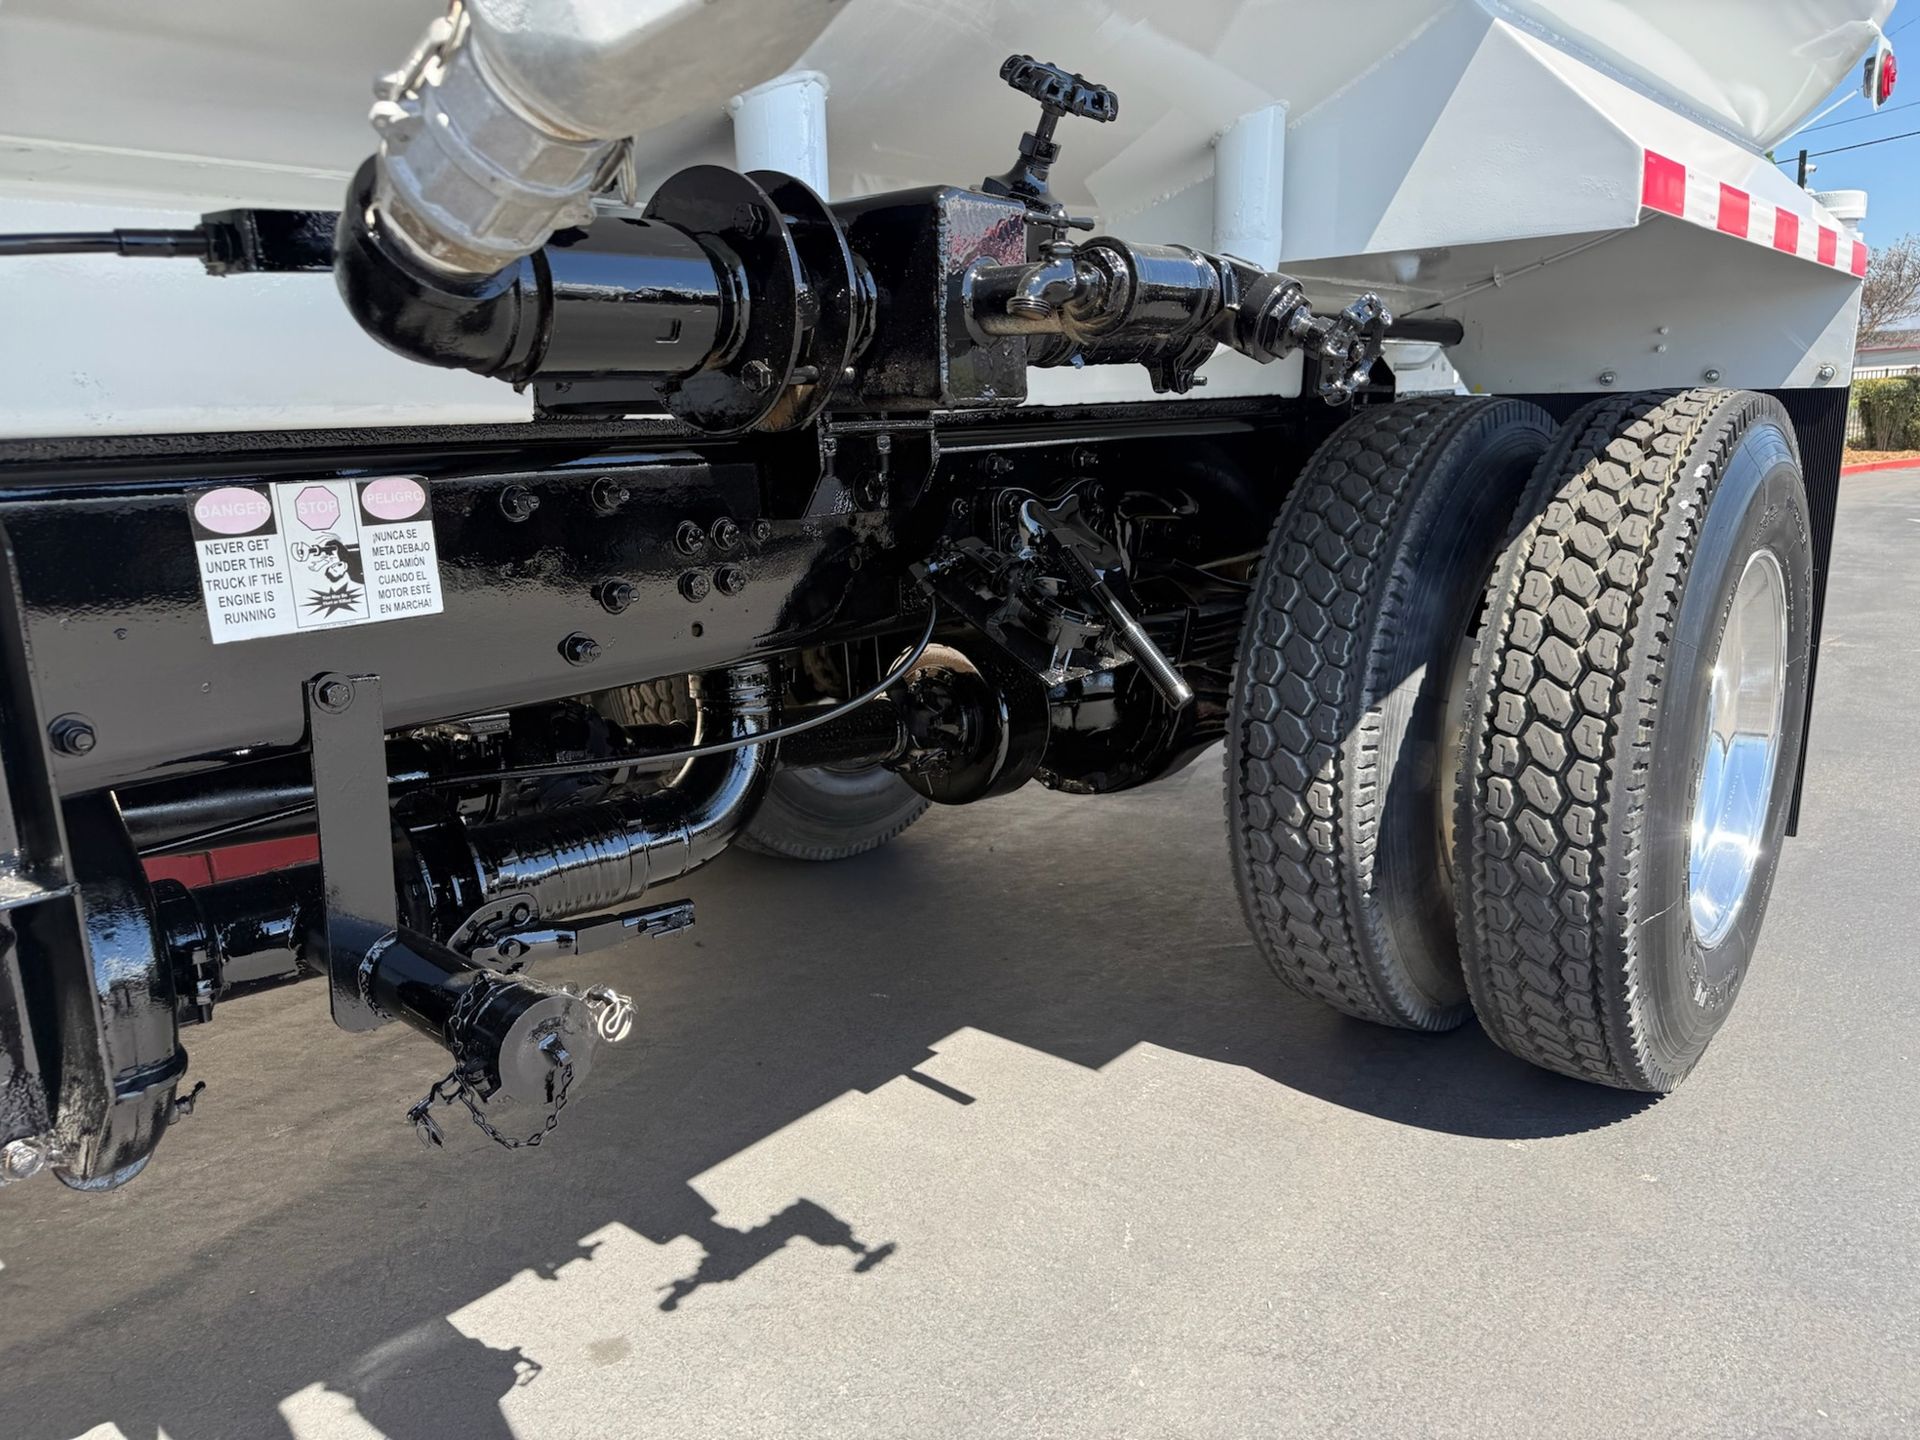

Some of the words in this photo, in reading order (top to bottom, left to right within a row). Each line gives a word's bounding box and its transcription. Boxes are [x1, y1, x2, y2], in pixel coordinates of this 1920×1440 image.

[366, 490, 422, 504] PELIGRO
[199, 502, 269, 518] DANGER
[299, 500, 337, 514] STOP
[406, 529, 418, 539] SE
[205, 541, 245, 556] NEVER
[247, 538, 269, 551] GET
[372, 545, 395, 557] META
[396, 542, 431, 554] DEBAJO
[205, 558, 247, 574] UNDER
[249, 556, 275, 569] THIS
[374, 560, 391, 571] DEL
[392, 554, 426, 569] CAMIÓN
[205, 576, 246, 592] TRUCK
[248, 575, 258, 587] IF
[260, 572, 284, 585] THE
[378, 572, 415, 585] CUANDO
[416, 571, 427, 581] EL
[378, 586, 409, 600] MOTOR
[410, 581, 432, 596] ESTÉ
[218, 592, 262, 608] ENGINE
[264, 590, 275, 602] IS
[380, 603, 392, 614] EN
[393, 598, 432, 612] MARCHA!
[224, 608, 276, 625] RUNNING
